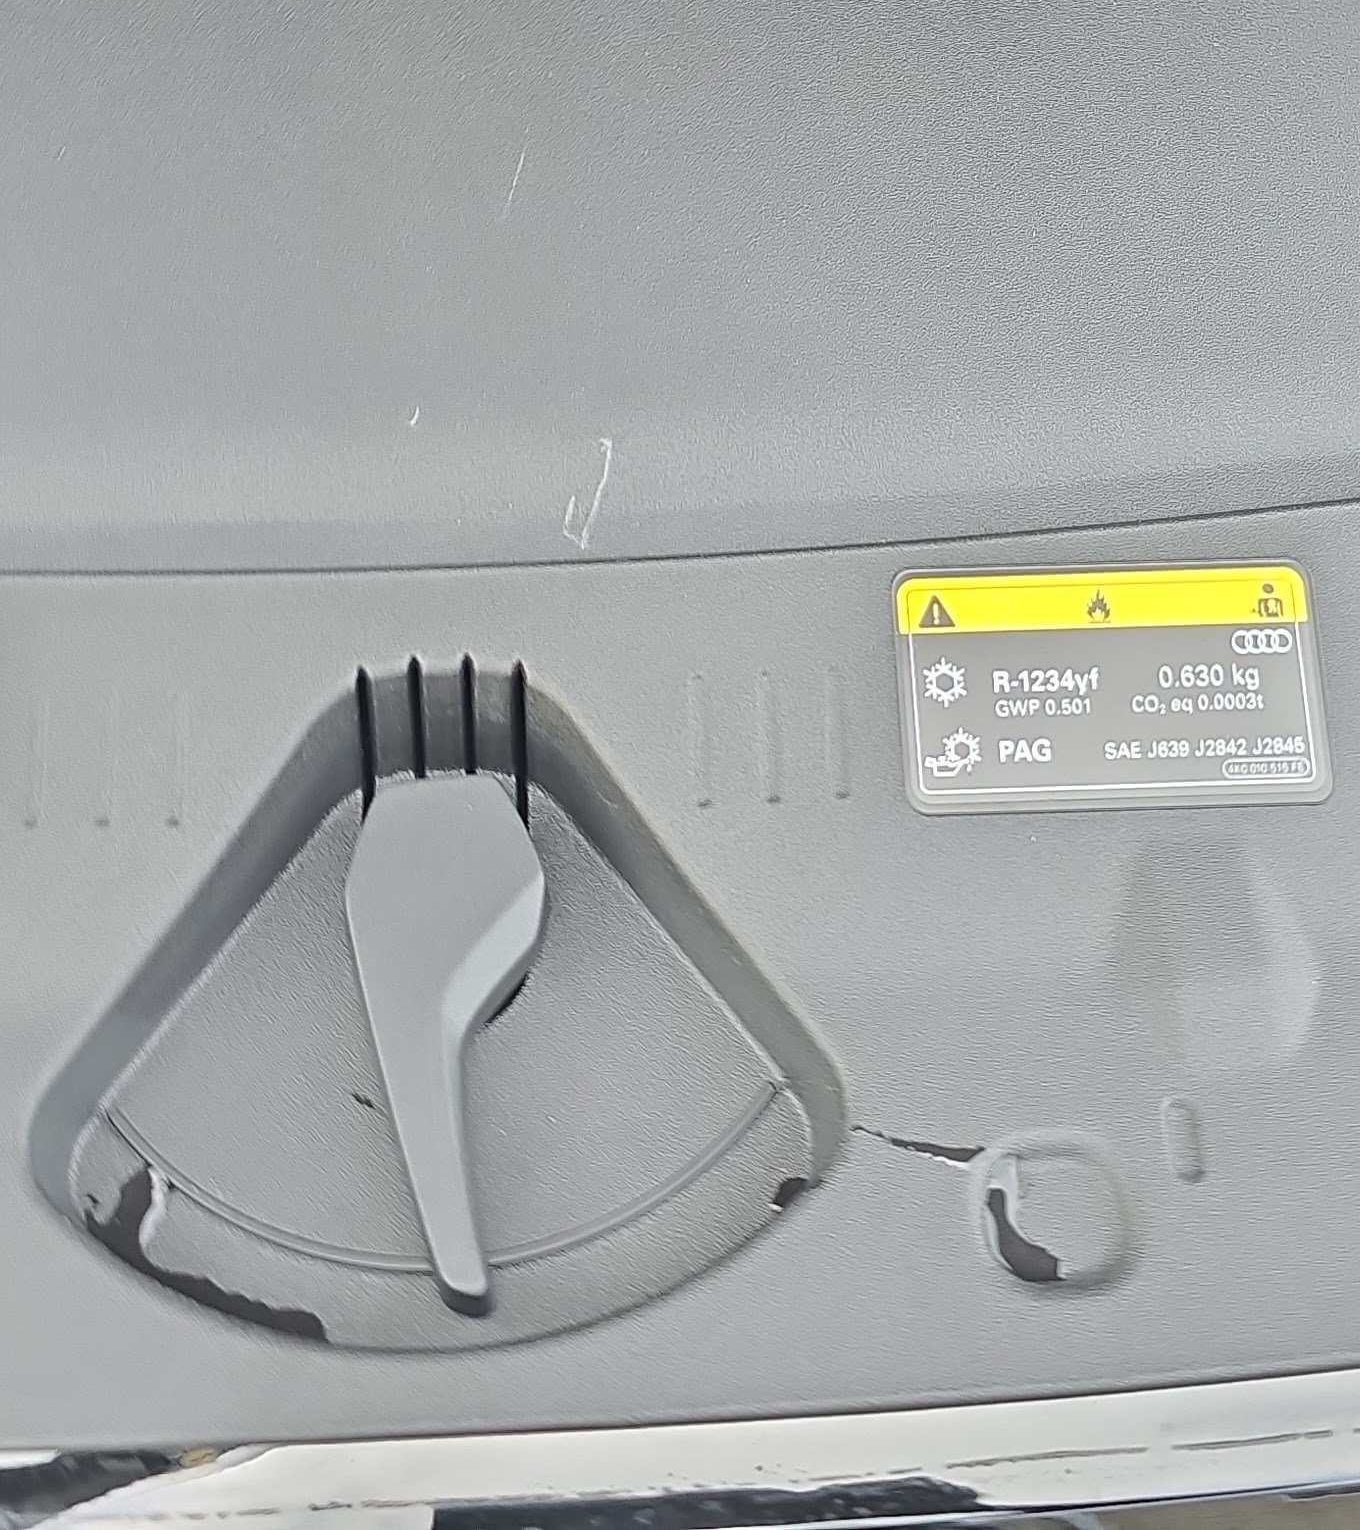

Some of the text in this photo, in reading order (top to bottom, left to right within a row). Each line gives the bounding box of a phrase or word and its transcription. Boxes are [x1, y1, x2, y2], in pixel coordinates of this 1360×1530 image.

[992, 666, 1098, 695] R-1234yf
[1158, 662, 1259, 690] 0.630 kg
[994, 697, 1090, 717] GWP 0.501
[1170, 697, 1193, 714] eq
[1197, 691, 1263, 710] 0.0003t
[998, 738, 1051, 762] PAG
[1104, 735, 1305, 759] SAE J639 J2842 J2845
[1249, 763, 1267, 774] 010
